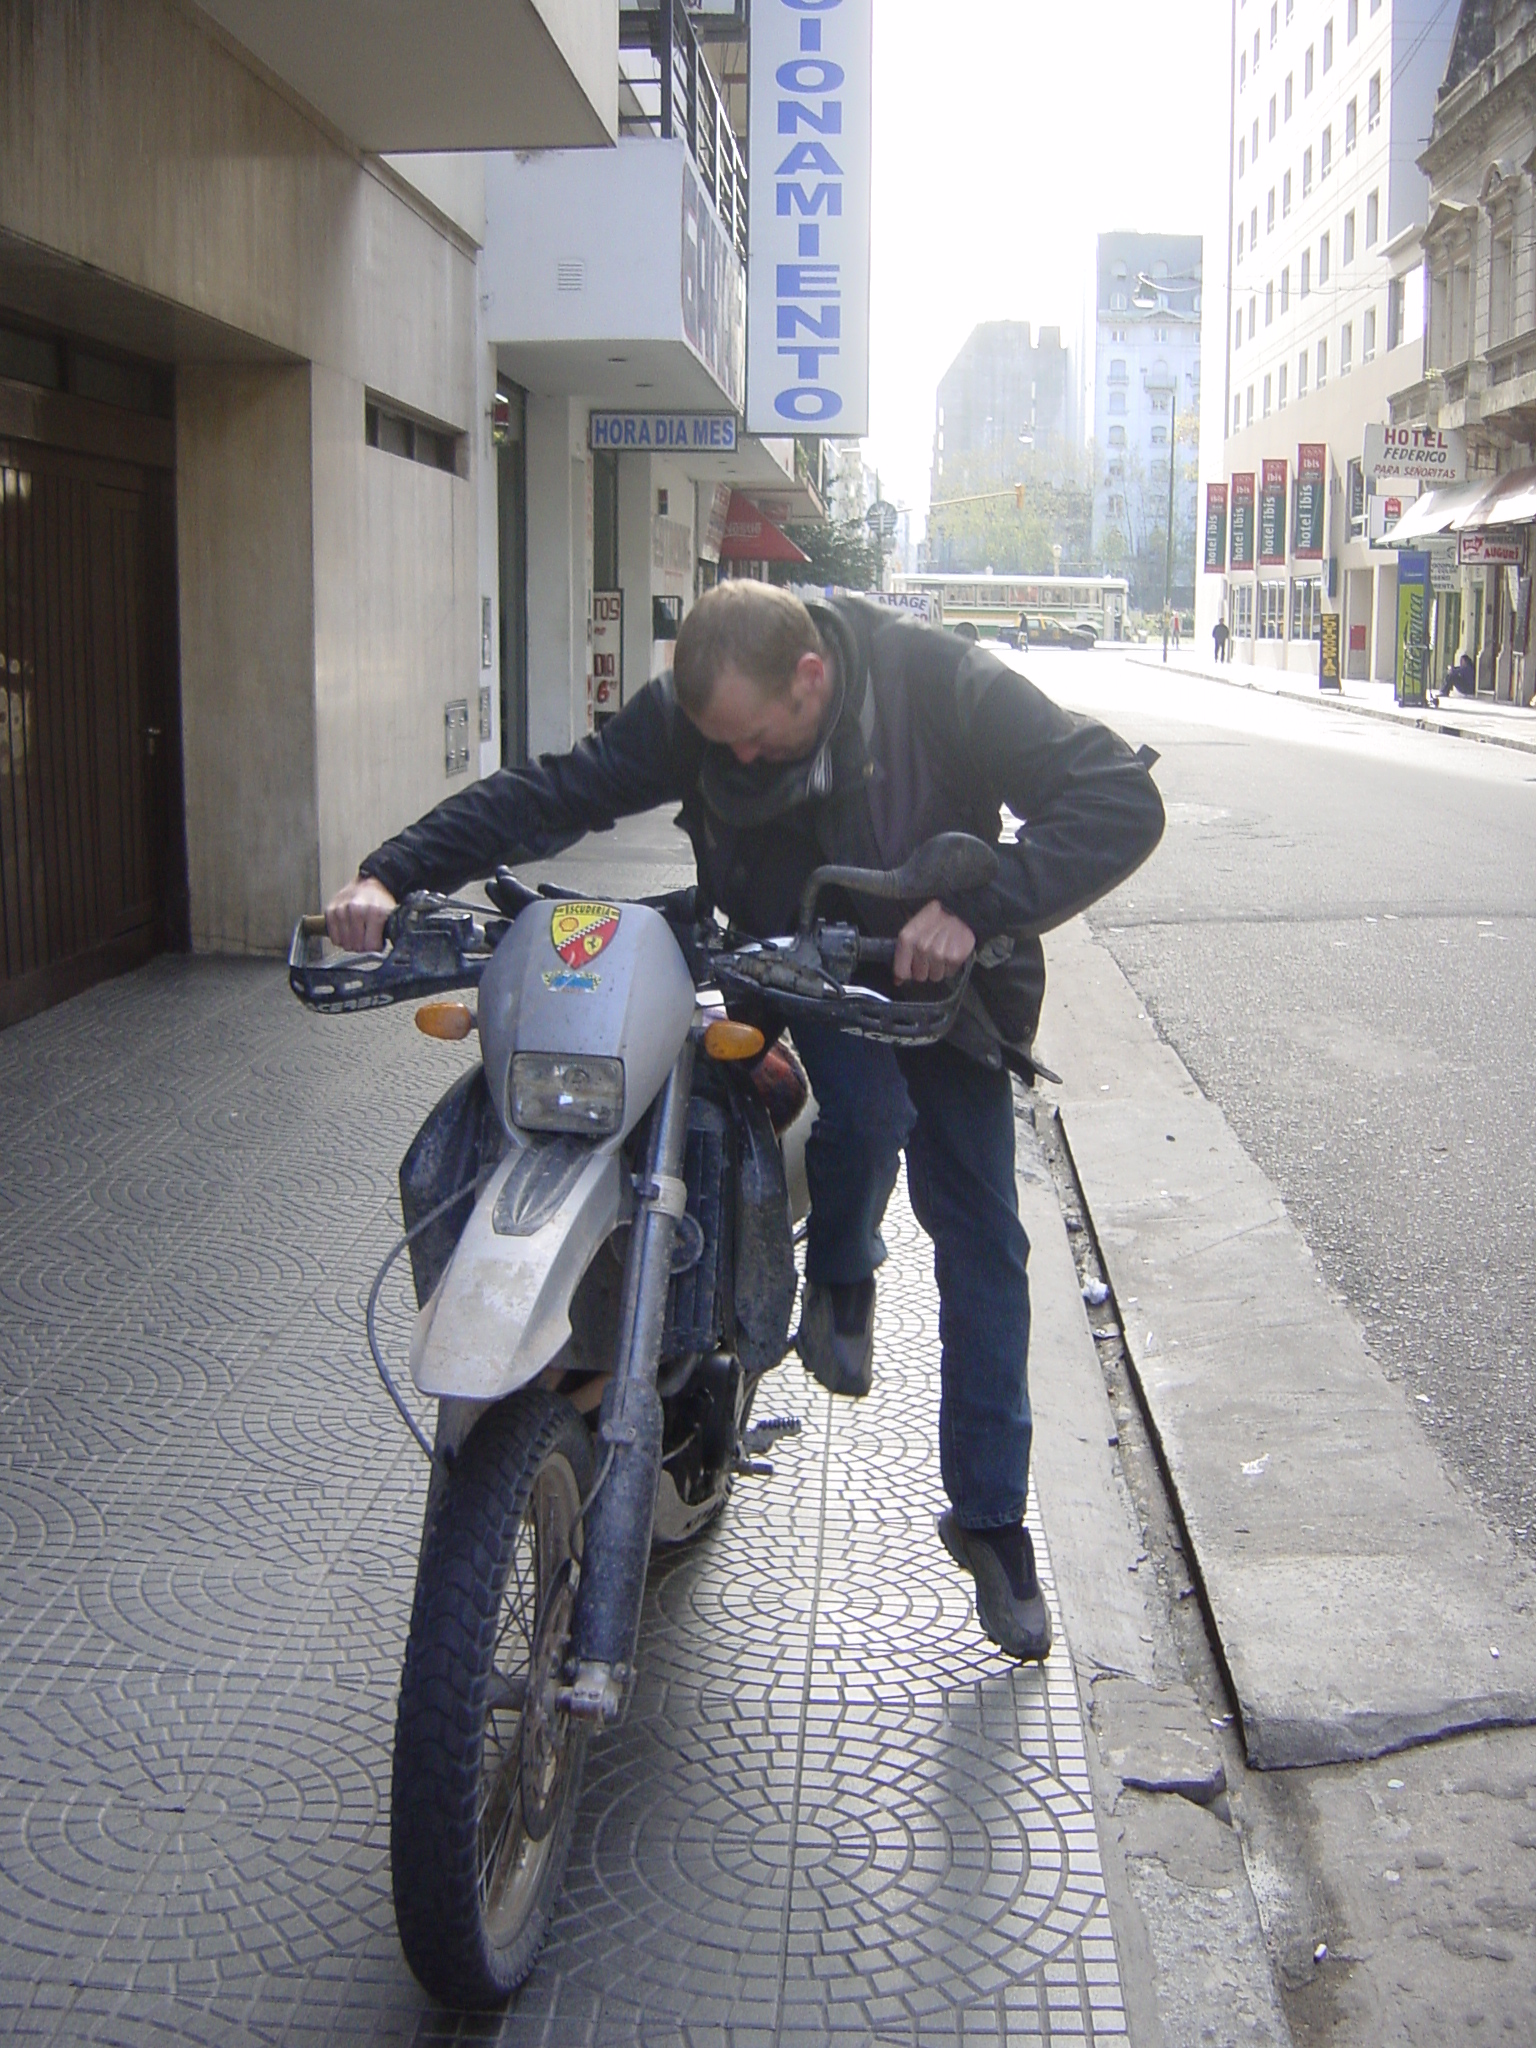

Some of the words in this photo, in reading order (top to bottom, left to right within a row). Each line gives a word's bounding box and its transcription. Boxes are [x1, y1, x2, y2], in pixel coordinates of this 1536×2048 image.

[594, 418, 650, 445] HORA
[655, 419, 688, 446] DIA
[693, 419, 734, 446] MES
[1384, 428, 1448, 449] HOTEL
[1383, 447, 1447, 464] FEDERICO
[1373, 464, 1400, 476] PARA
[1263, 496, 1276, 519] ibis
[1299, 484, 1312, 509] ibis
[1207, 514, 1218, 534] ibis
[1233, 507, 1244, 528] ibis
[1262, 523, 1275, 555] hotel
[1299, 513, 1312, 548] hotel
[1206, 535, 1217, 565] hotel
[1233, 531, 1244, 561] hotel
[565, 905, 610, 917] ESCUDERIA
